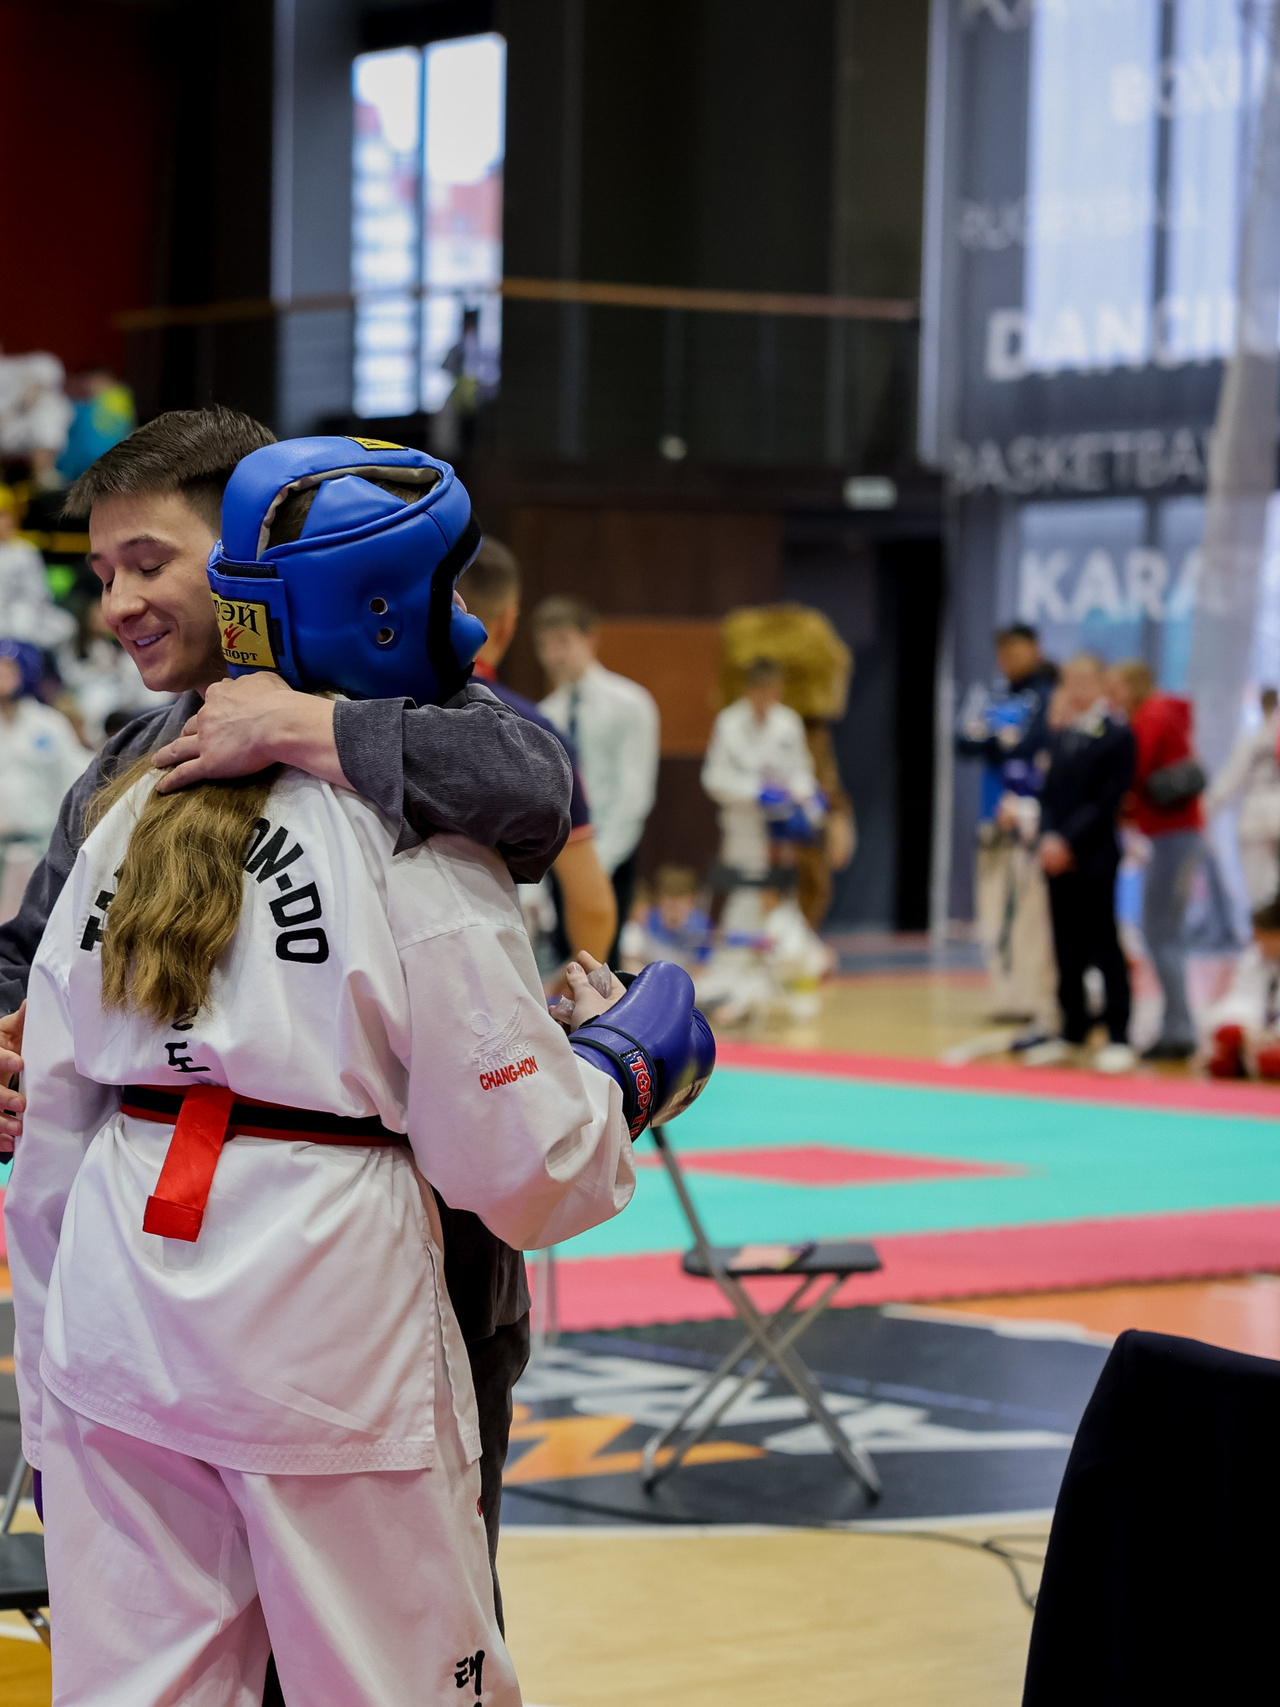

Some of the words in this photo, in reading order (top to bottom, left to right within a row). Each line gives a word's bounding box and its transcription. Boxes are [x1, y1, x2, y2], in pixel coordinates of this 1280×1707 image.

[222, 648, 258, 664] порт
[479, 1055, 539, 1091] CHANG-HON
[629, 1056, 651, 1109] TOP
